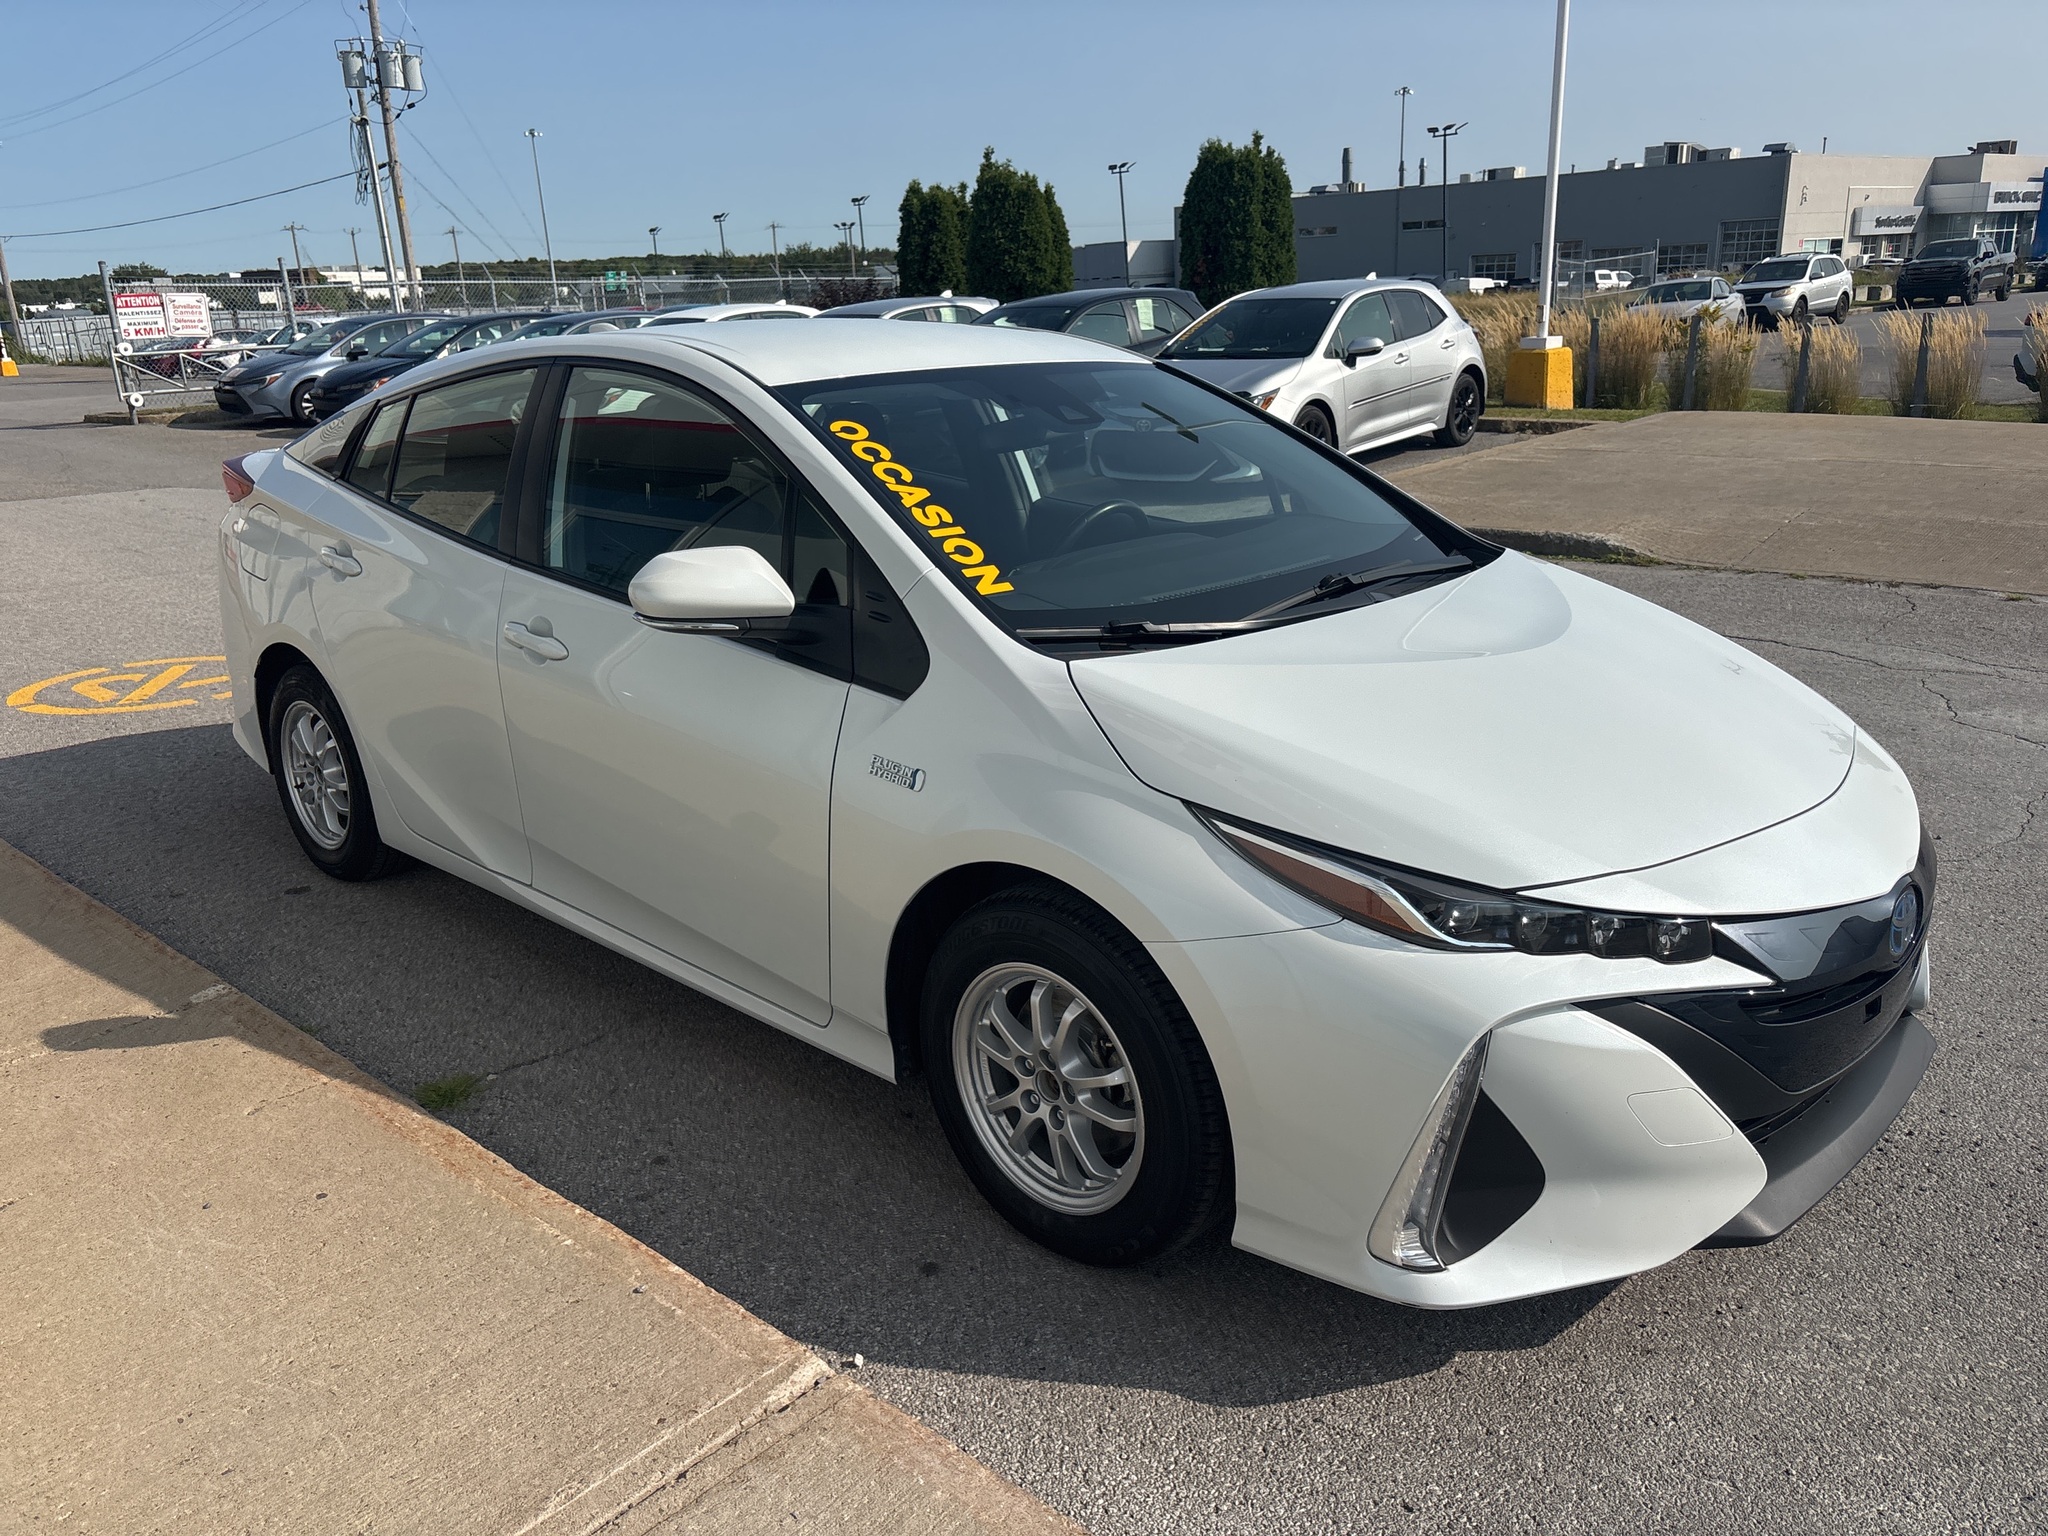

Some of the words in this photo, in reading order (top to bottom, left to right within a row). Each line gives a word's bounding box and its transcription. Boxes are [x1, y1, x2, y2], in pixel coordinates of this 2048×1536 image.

[116, 295, 161, 307] ATTENTION
[123, 328, 130, 337] 5
[134, 327, 165, 336] KM/H
[829, 420, 1015, 596] OCCASION
[868, 765, 911, 788] HYBRID
